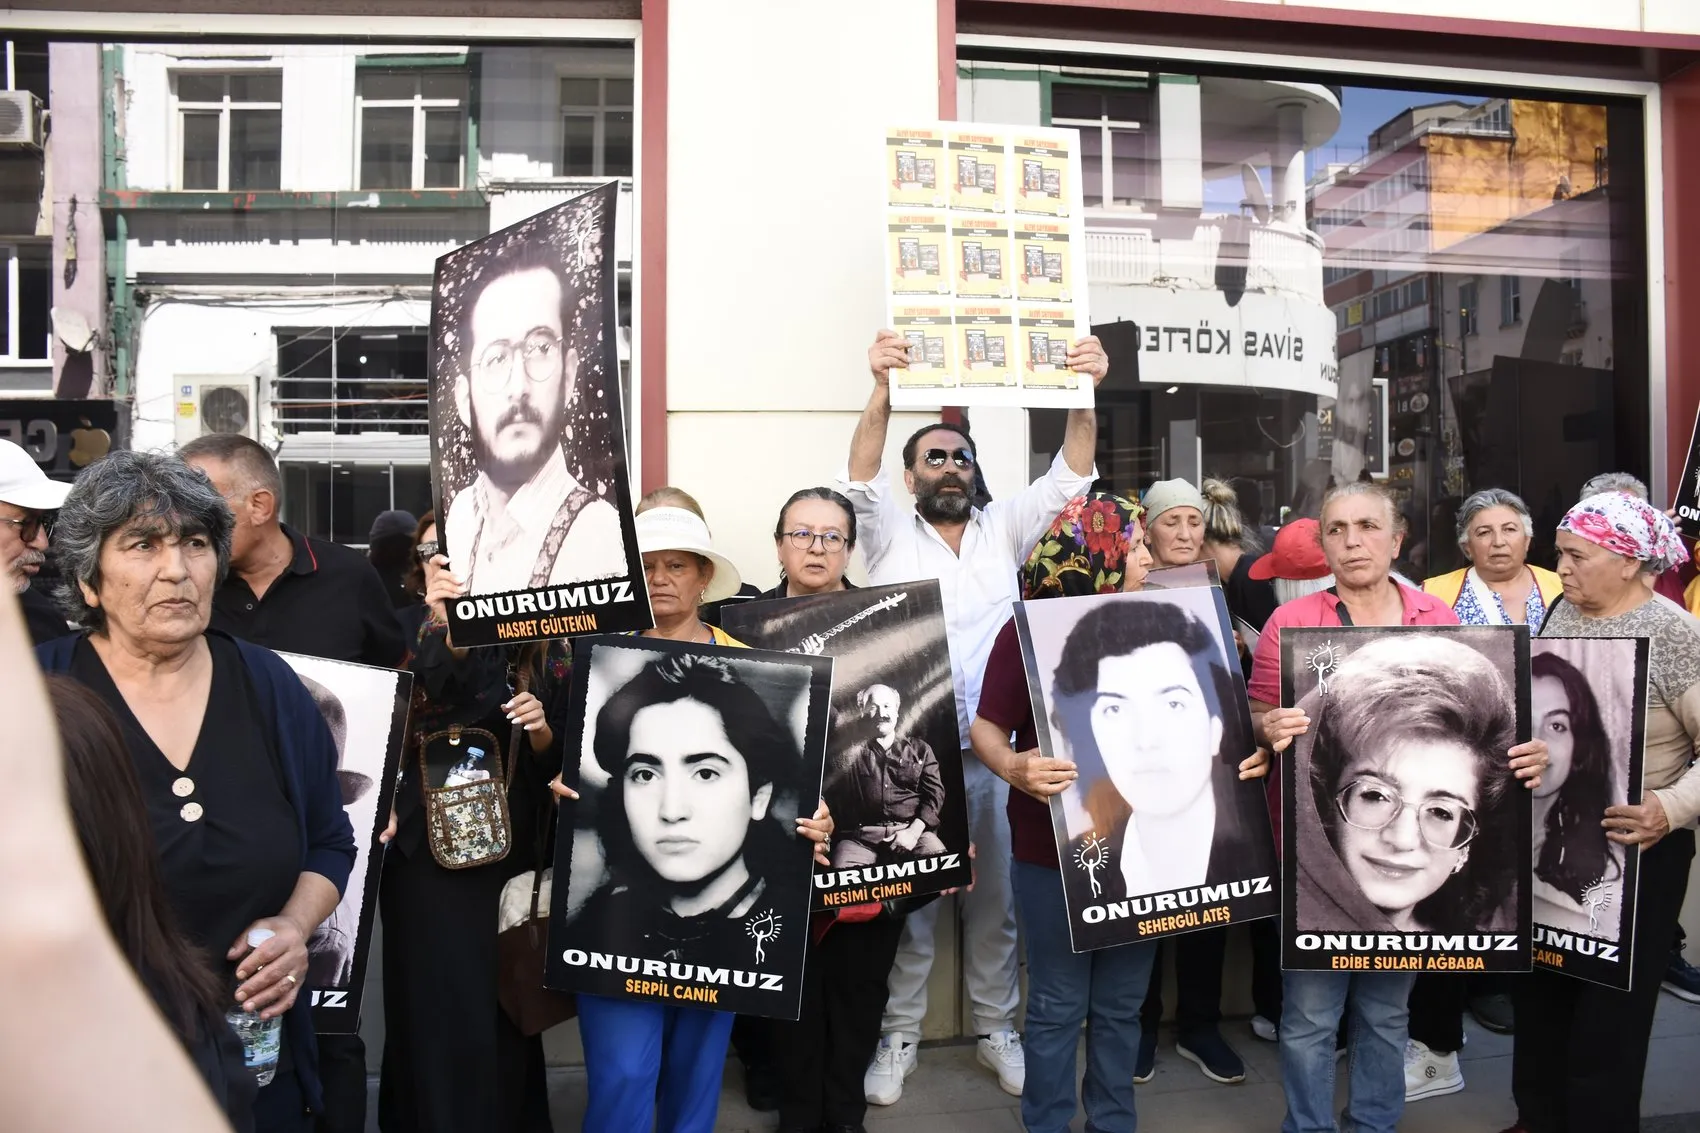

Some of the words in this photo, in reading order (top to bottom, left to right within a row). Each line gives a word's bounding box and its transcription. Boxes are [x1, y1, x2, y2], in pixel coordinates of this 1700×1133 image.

[455, 581, 635, 621] ONURUMUZ
[496, 619, 538, 639] HASRET
[541, 611, 597, 636] GÜLTEKİN
[823, 886, 868, 906] NESİMİ
[871, 882, 912, 902] ÇİMEN
[1082, 876, 1273, 924] ONURUMUZ
[1138, 911, 1201, 936] SEHERGÜL
[1202, 906, 1231, 924] ATEŞ
[1295, 934, 1519, 951] ONURUMUZ
[562, 949, 784, 992] ONURUMUZ
[1331, 953, 1371, 970] EDİBE
[1374, 954, 1423, 970] SULARİ
[1427, 953, 1485, 970] AĞBABA
[625, 978, 669, 999] SERPİL
[673, 985, 718, 1004] CANİK
